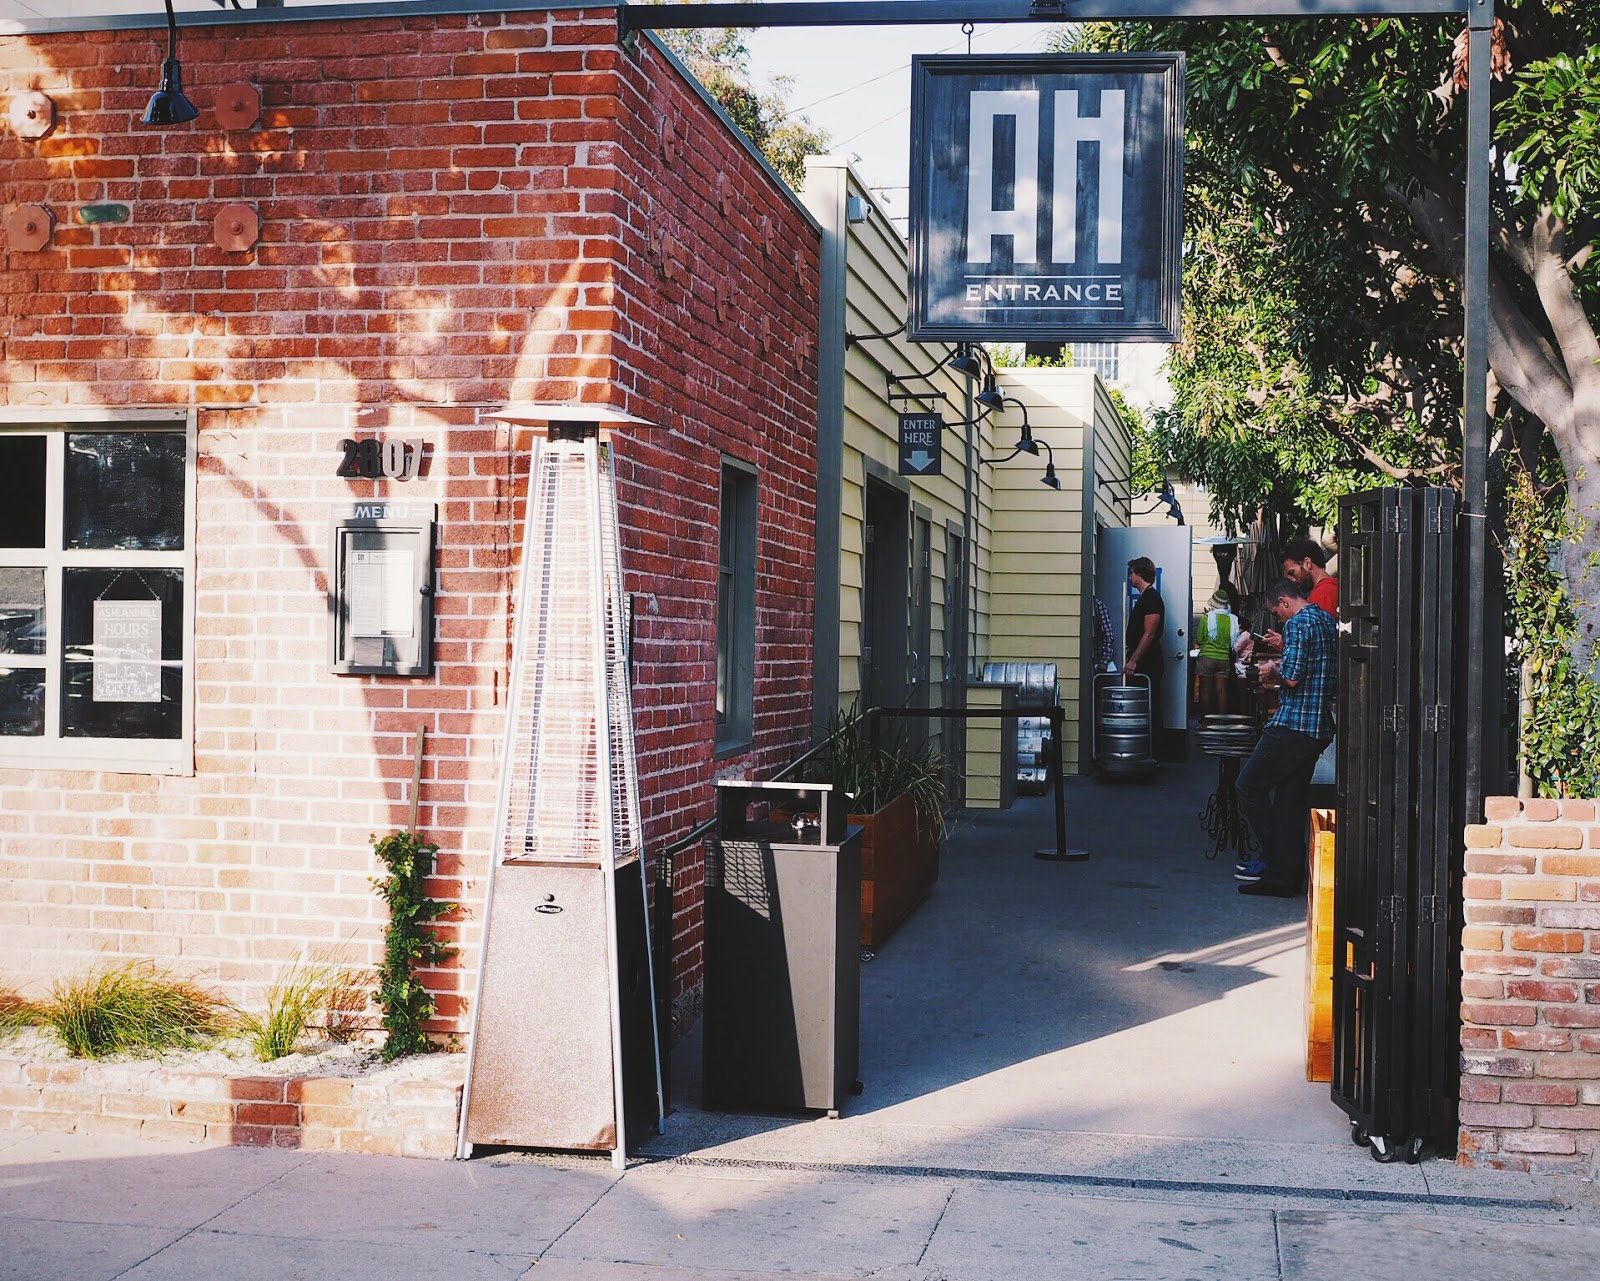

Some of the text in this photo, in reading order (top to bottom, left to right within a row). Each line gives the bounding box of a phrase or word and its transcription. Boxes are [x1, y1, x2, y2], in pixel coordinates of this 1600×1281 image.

[967, 90, 1125, 263] AH
[966, 284, 1121, 301] ENTRANCE
[903, 419, 935, 430] ENTER
[904, 432, 936, 446] HERE
[336, 438, 424, 479] 2807
[354, 506, 409, 519] MENU
